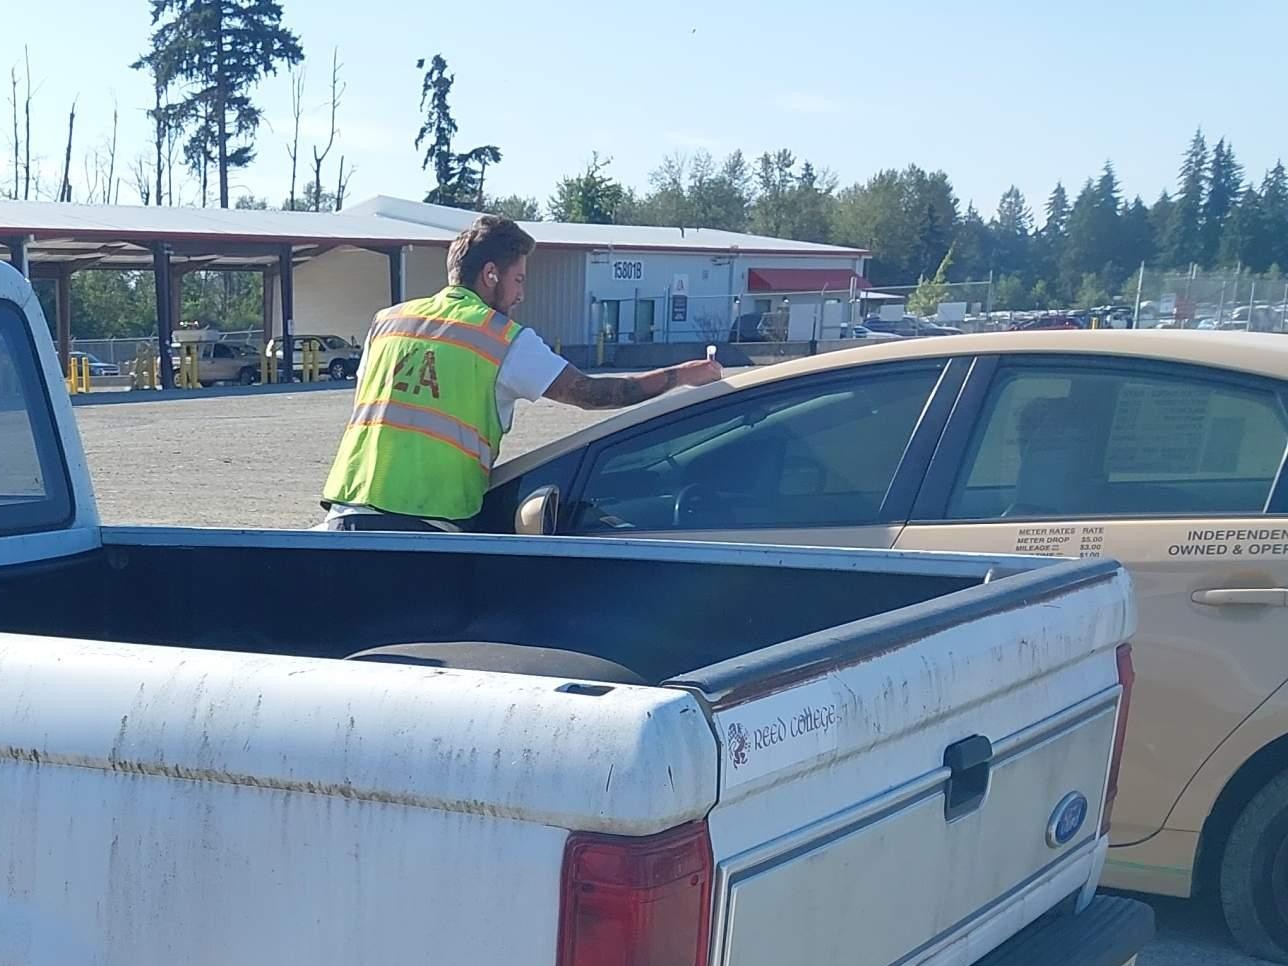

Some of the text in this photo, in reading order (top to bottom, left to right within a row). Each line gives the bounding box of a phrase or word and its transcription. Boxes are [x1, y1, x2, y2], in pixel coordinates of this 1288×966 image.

[1019, 527, 1076, 536] METER RATES
[1188, 529, 1288, 541] INDEPENDEN
[1168, 544, 1228, 556] OWNED
[1232, 544, 1243, 555] &
